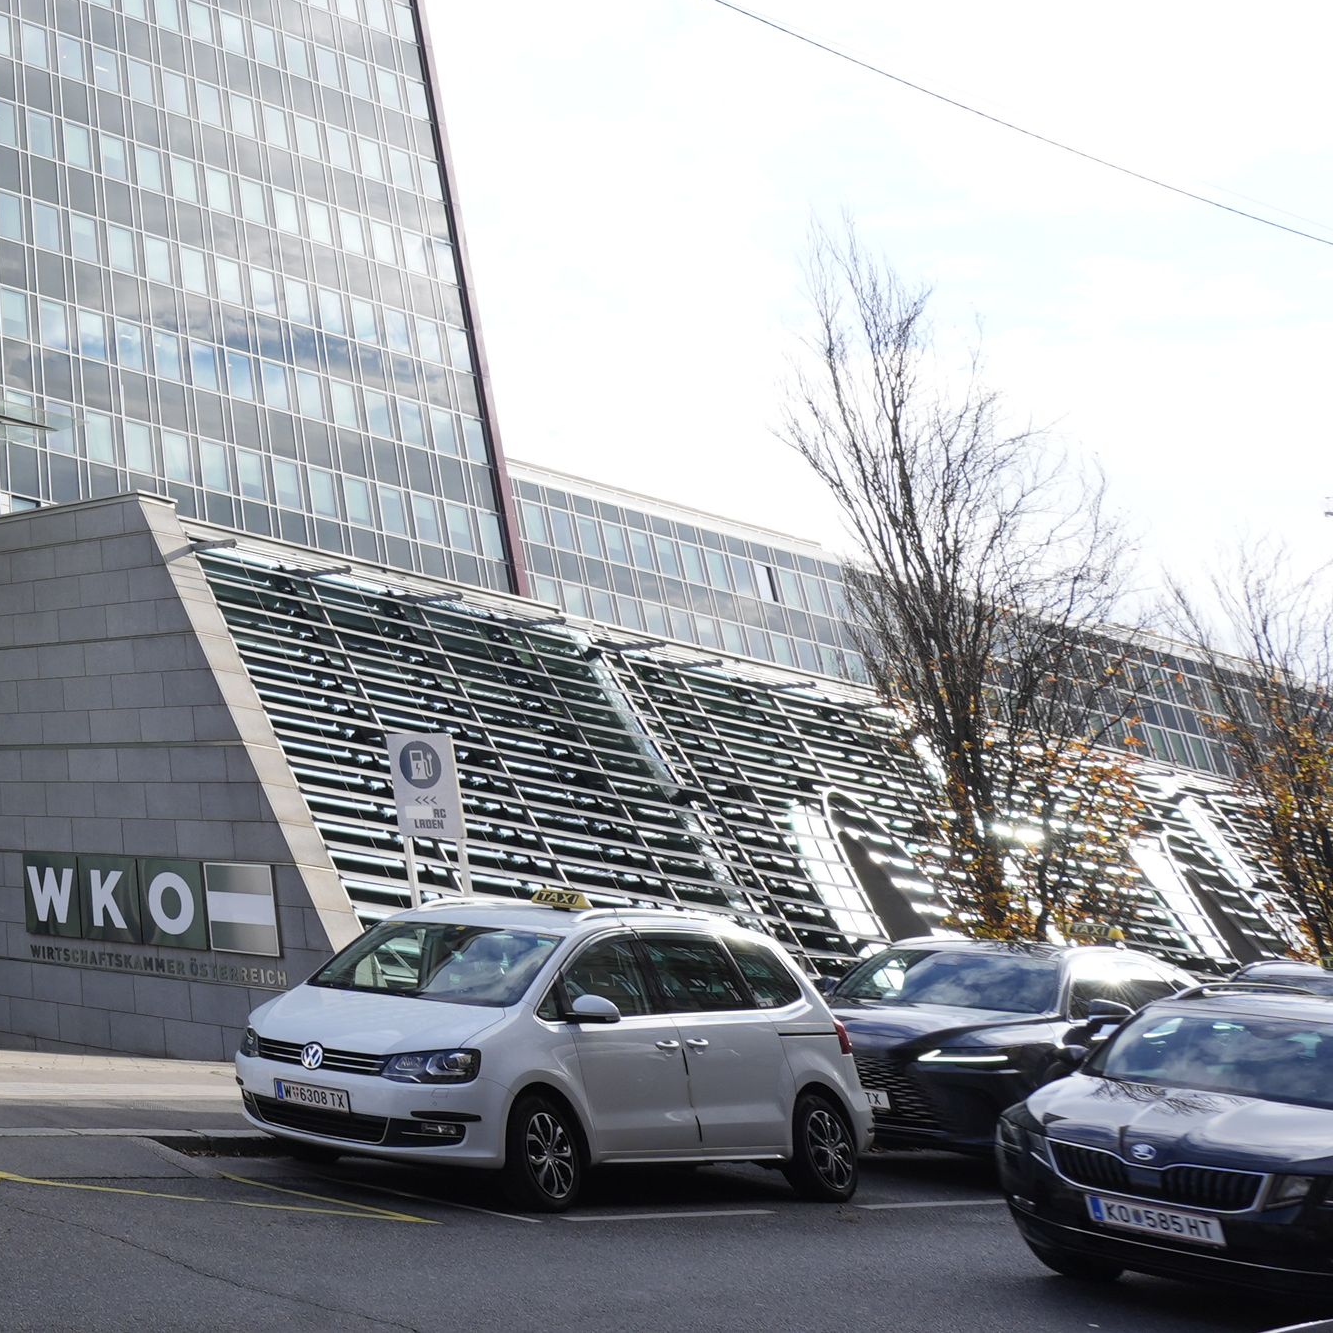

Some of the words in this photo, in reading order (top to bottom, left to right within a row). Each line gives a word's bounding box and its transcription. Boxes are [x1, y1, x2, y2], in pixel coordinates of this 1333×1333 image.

[26, 865, 195, 936] WKO
[540, 891, 579, 904] TAXI
[1073, 925, 1106, 936] TAXI
[30, 943, 185, 976] WIRTSCHAFTSKAMMER
[190, 957, 288, 987] ÖSTERREICH
